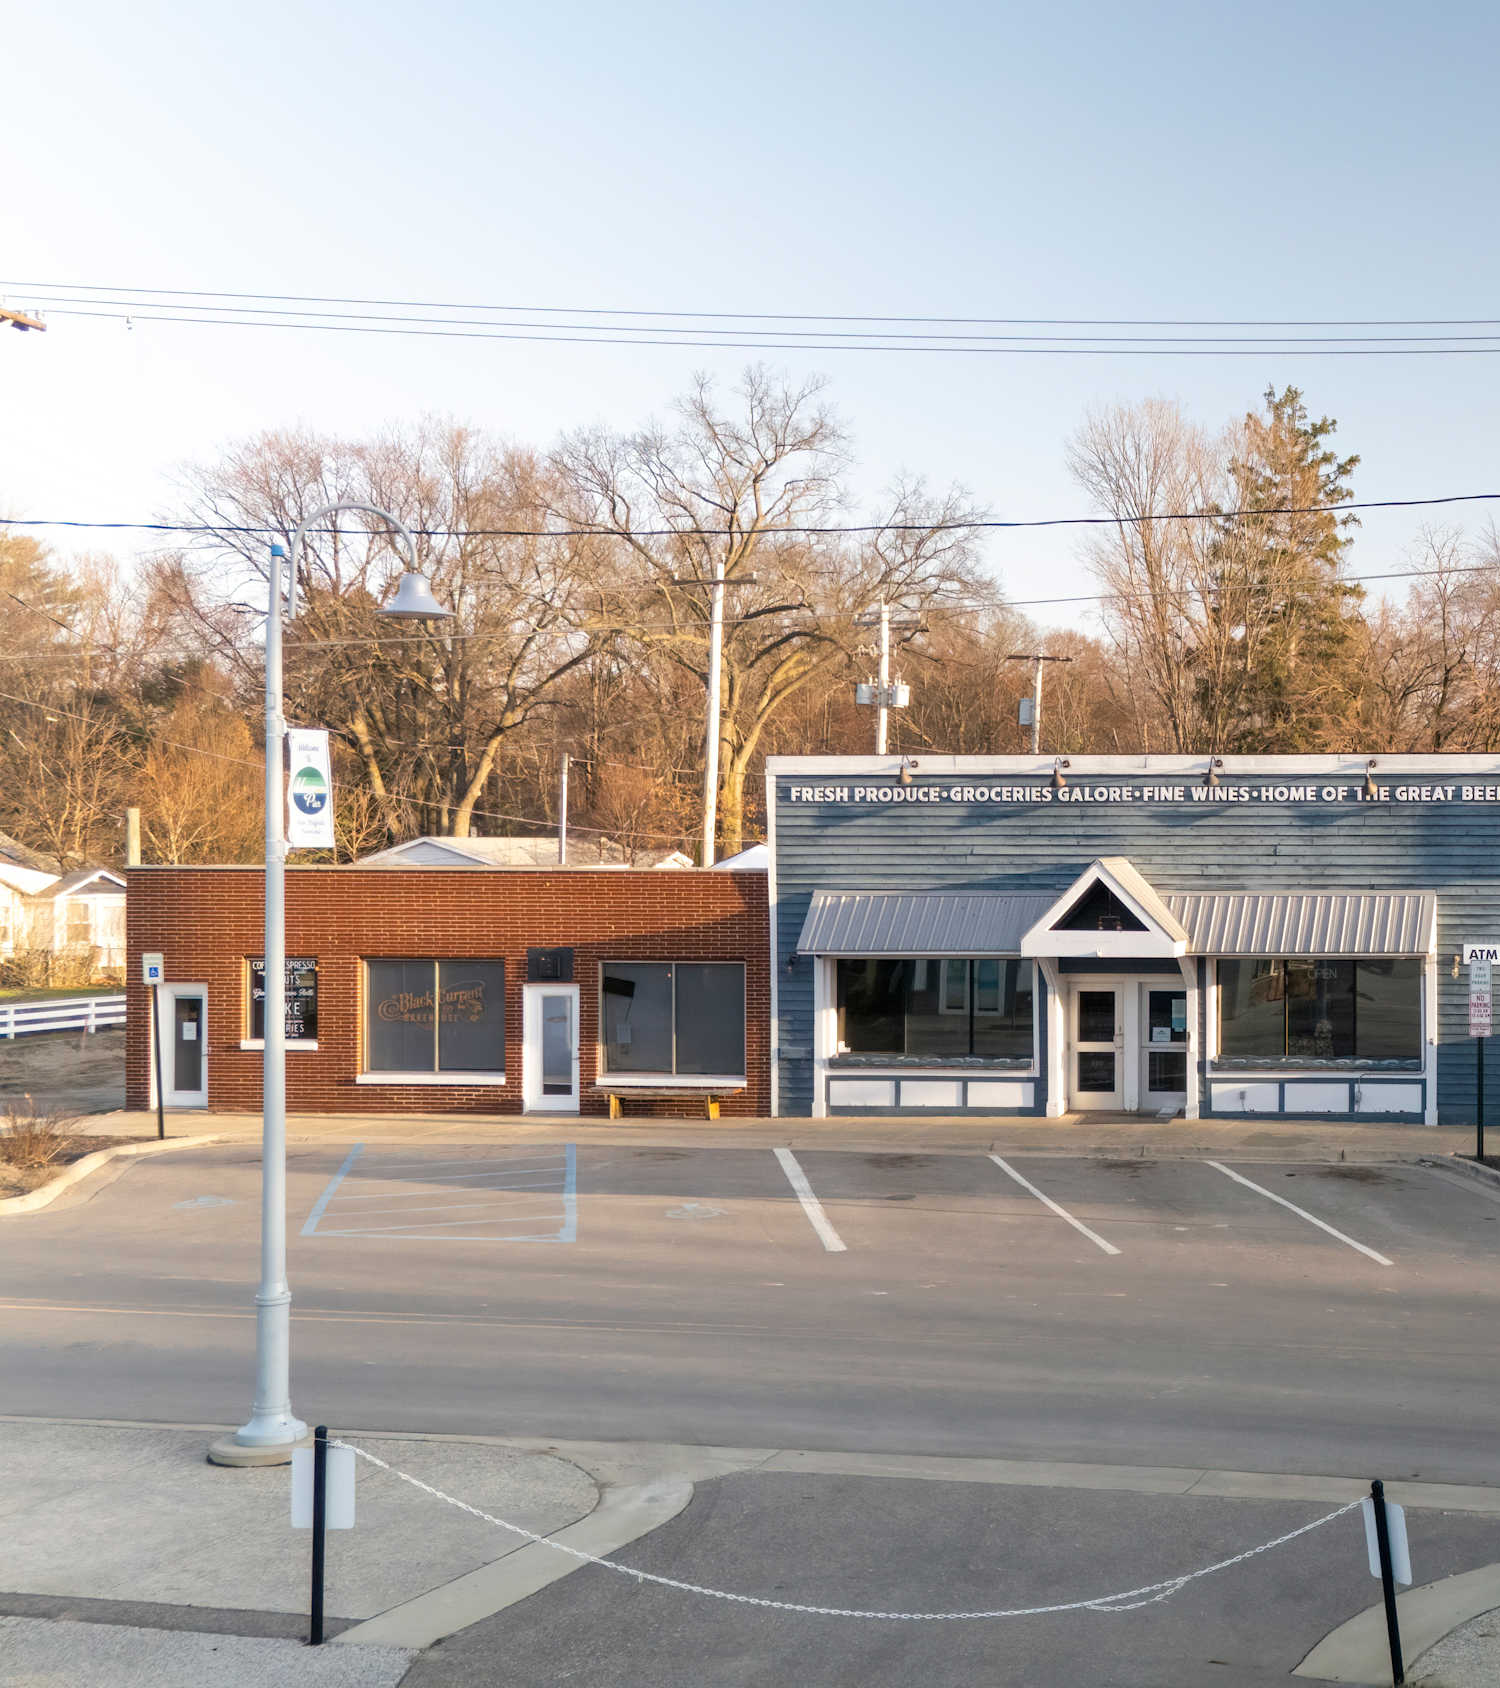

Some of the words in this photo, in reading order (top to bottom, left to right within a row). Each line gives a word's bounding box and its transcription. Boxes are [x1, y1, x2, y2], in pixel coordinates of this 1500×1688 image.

[791, 786, 849, 802] FRESH
[854, 786, 940, 802] PRODUCE
[949, 786, 1052, 802] GROCERIES
[1058, 786, 1134, 802] GALORE
[1143, 786, 1185, 802] FINE
[1191, 786, 1250, 802] WINES
[1261, 786, 1316, 802] HOME
[1322, 786, 1348, 802] OF
[1395, 786, 1456, 802] GREAT
[1469, 949, 1498, 960] ATM
